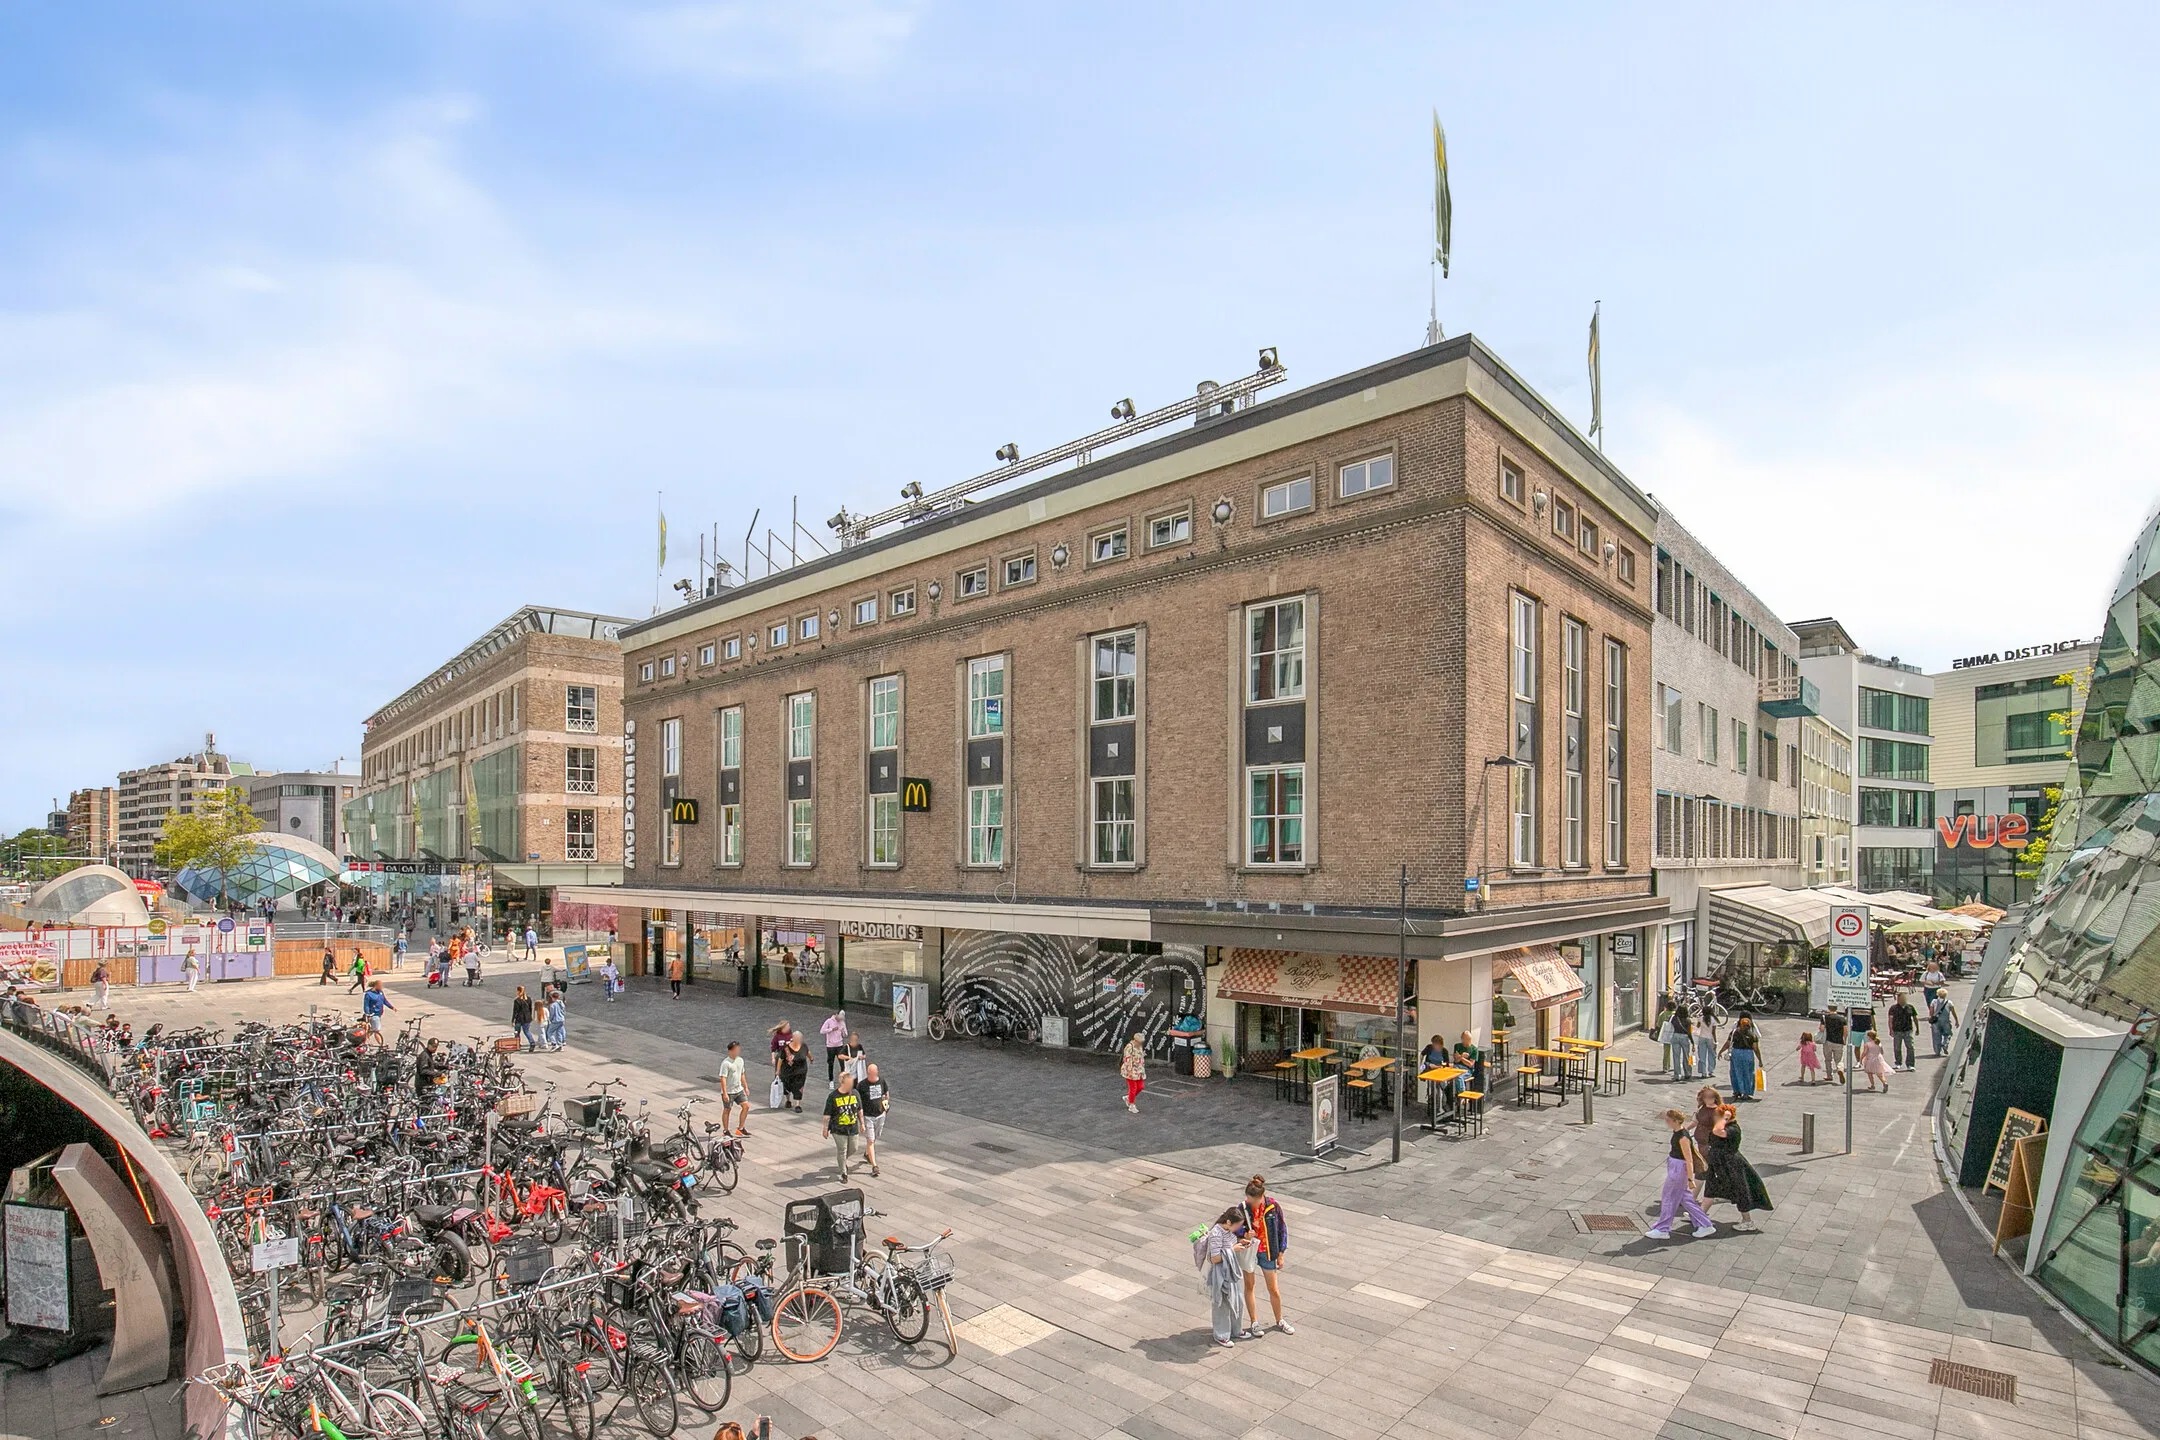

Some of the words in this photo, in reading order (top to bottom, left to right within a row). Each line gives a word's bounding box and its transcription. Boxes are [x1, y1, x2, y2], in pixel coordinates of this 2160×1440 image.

[1952, 653, 2000, 670] EMMA
[2004, 638, 2081, 662] DISTRICT
[624, 719, 637, 870] McDonald's
[839, 920, 917, 940] McDonald's
